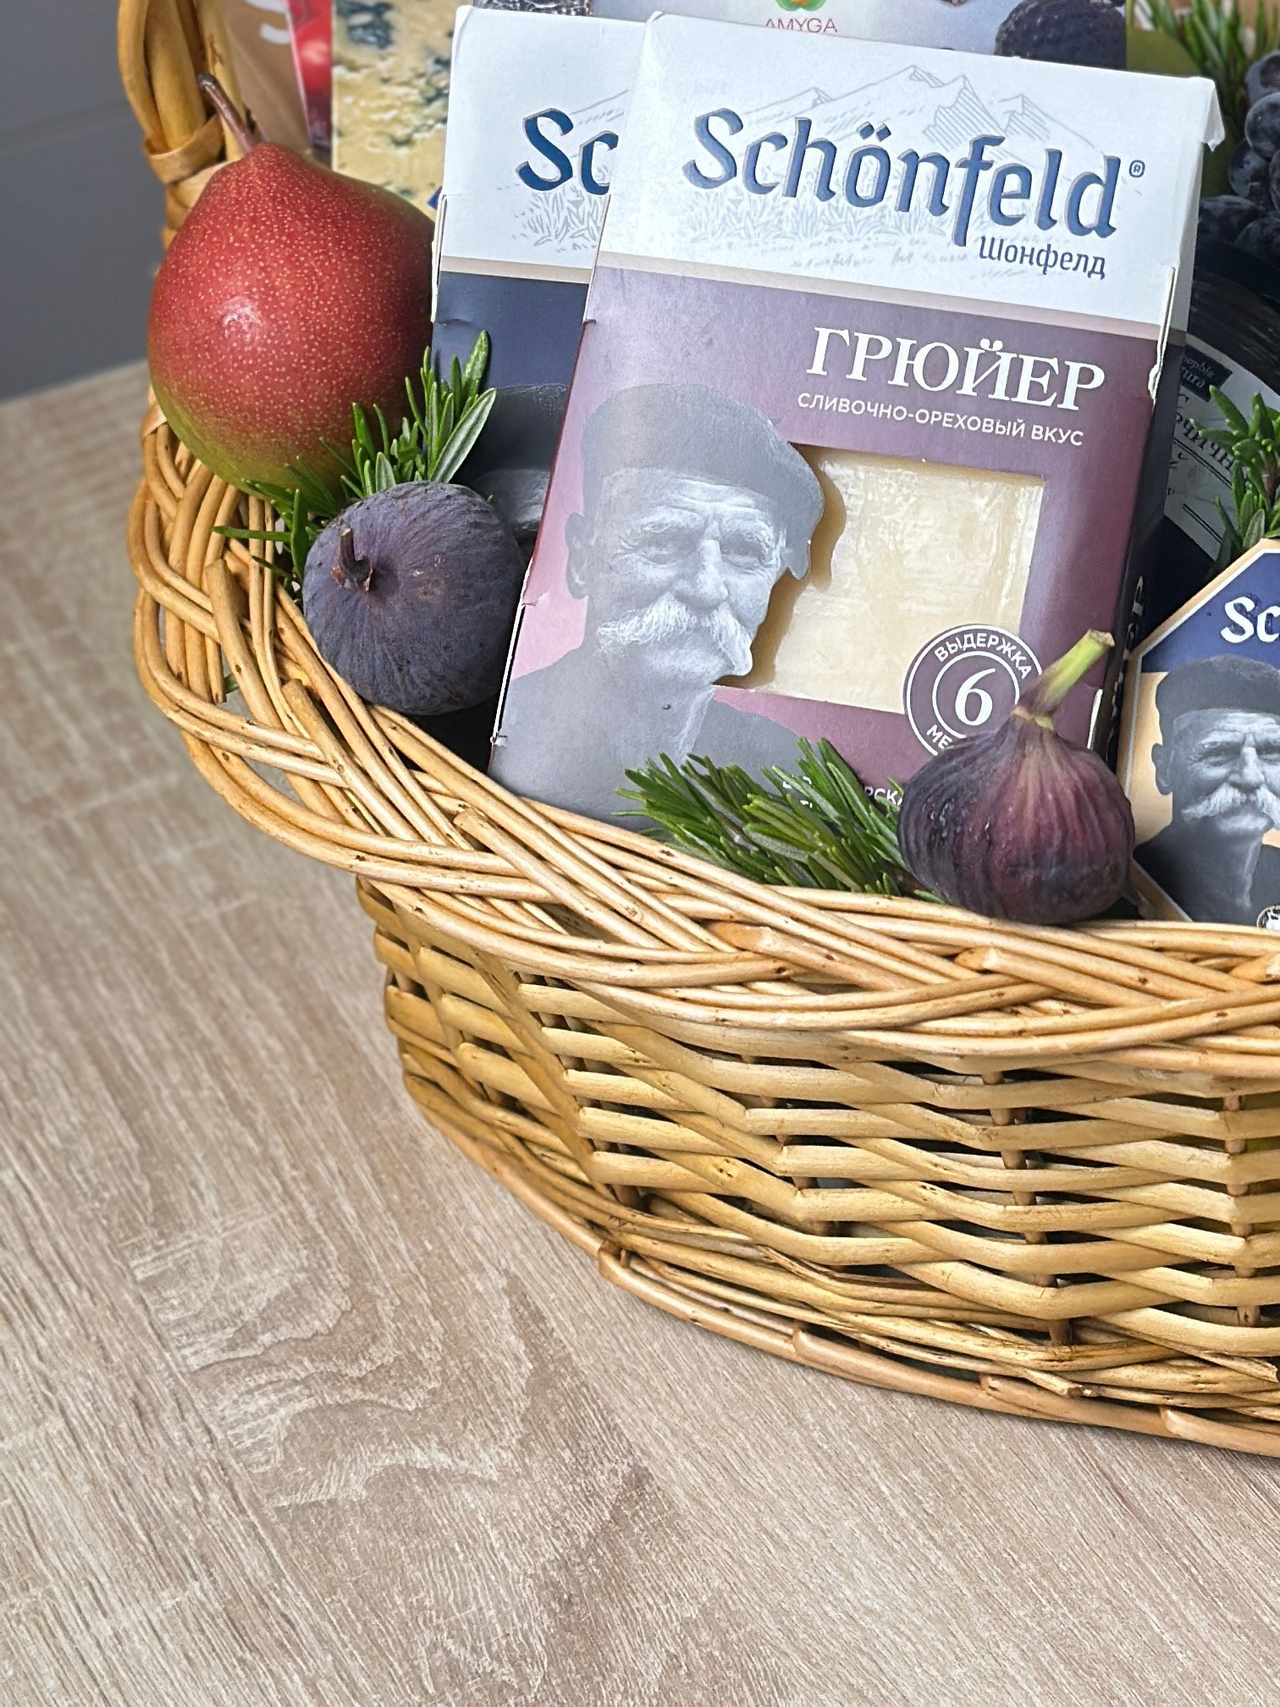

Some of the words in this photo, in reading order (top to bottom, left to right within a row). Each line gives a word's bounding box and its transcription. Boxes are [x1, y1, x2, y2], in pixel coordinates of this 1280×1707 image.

[765, 17, 838, 34] AMYGA
[978, 235, 1106, 279] Шонфелд
[806, 325, 1105, 411] ГРЮЙЕР
[798, 391, 1025, 438] СЛИВОЧНО-ОРЕХОВЫЙ
[1030, 422, 1084, 447] ВКУС
[934, 632, 1032, 680] ВЫДЕРЖКА
[955, 668, 996, 726] 6
